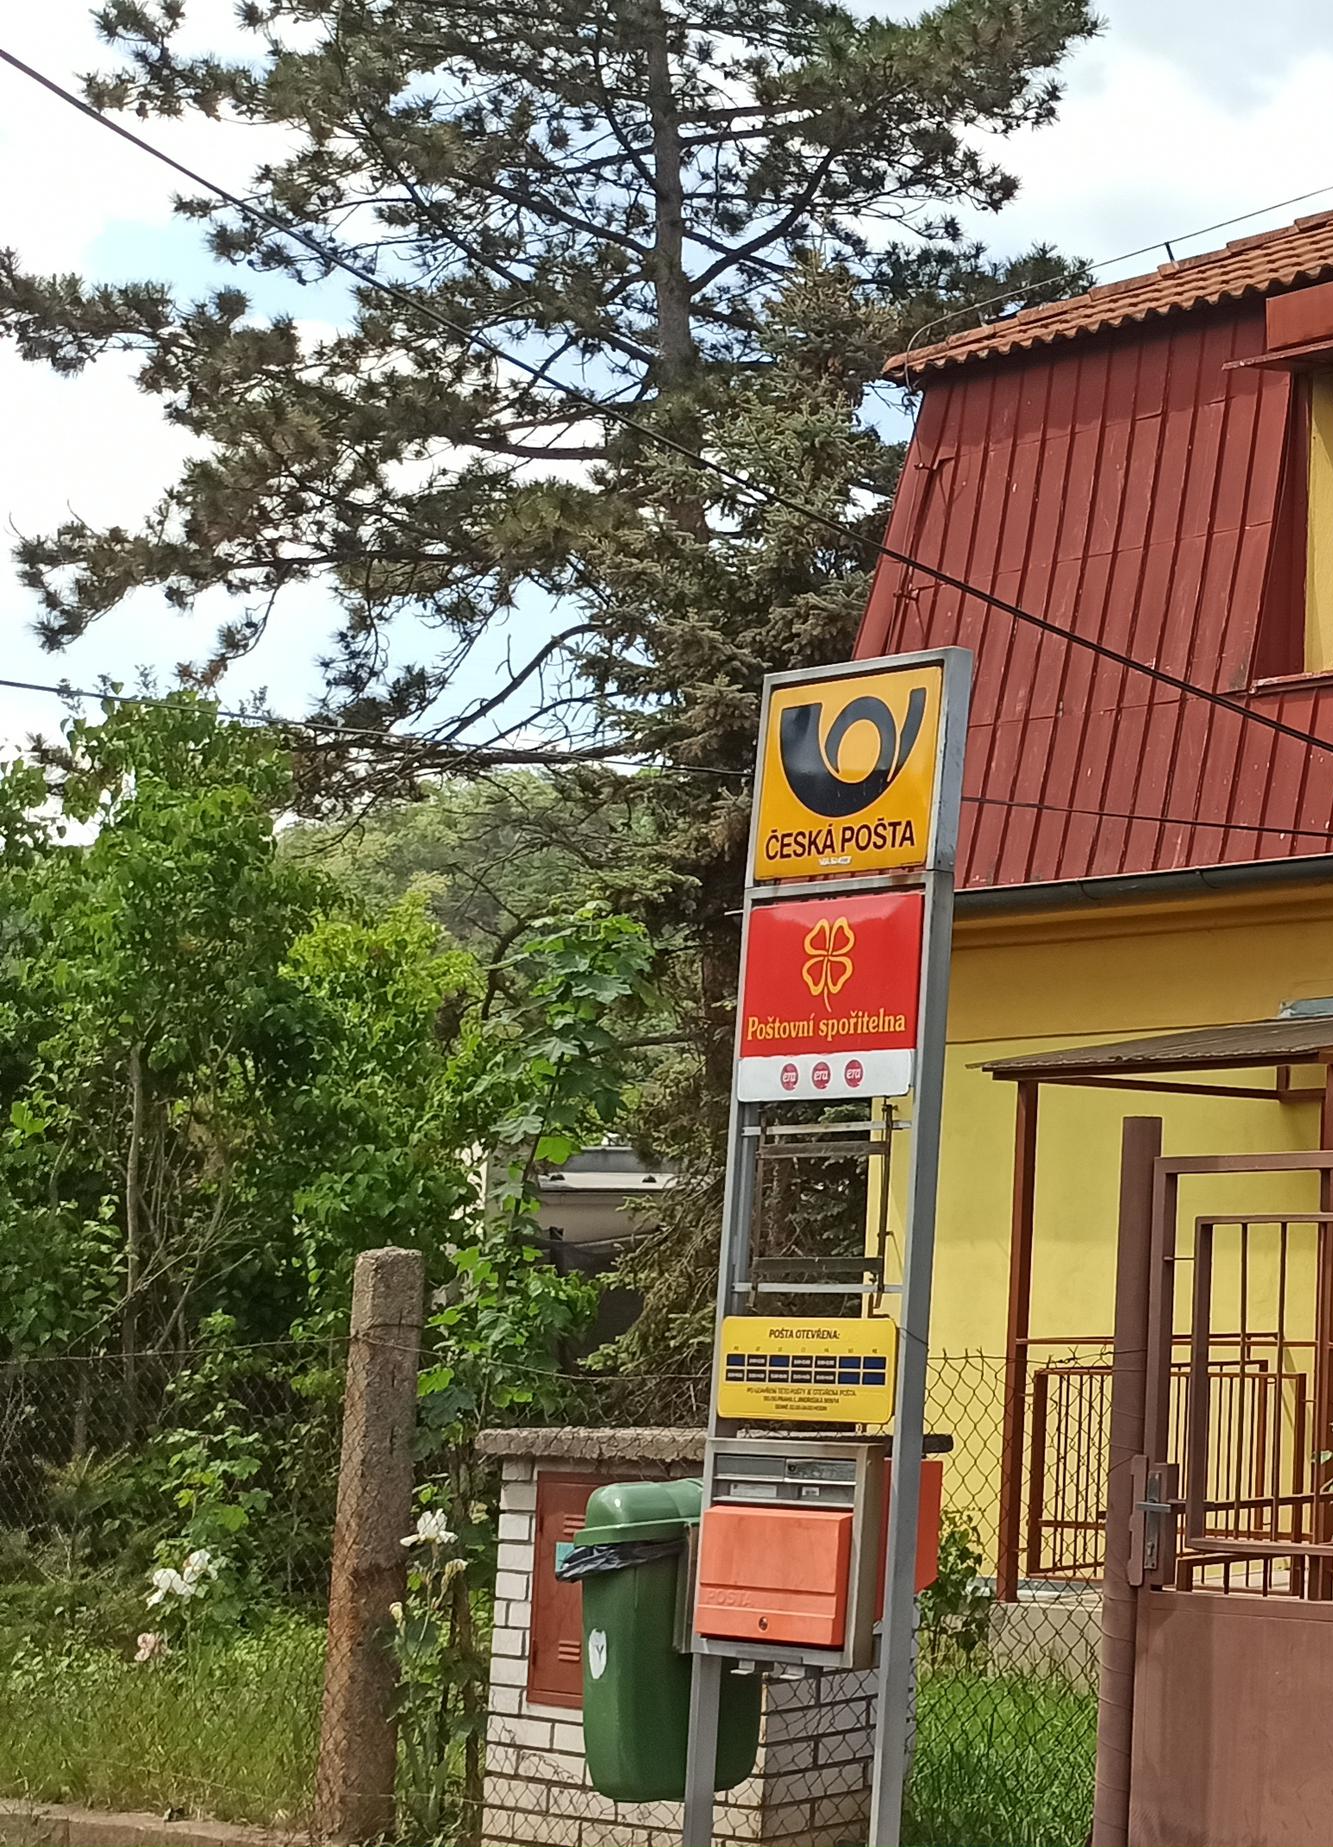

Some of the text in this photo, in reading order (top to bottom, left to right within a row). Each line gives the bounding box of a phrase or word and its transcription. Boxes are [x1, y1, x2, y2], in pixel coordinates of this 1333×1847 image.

[765, 817, 916, 861] ČESKÁ POŠTA
[747, 1007, 906, 1042] Poštovní spořitelna
[782, 1068, 861, 1083] era era era
[769, 1327, 794, 1339] POŠTA
